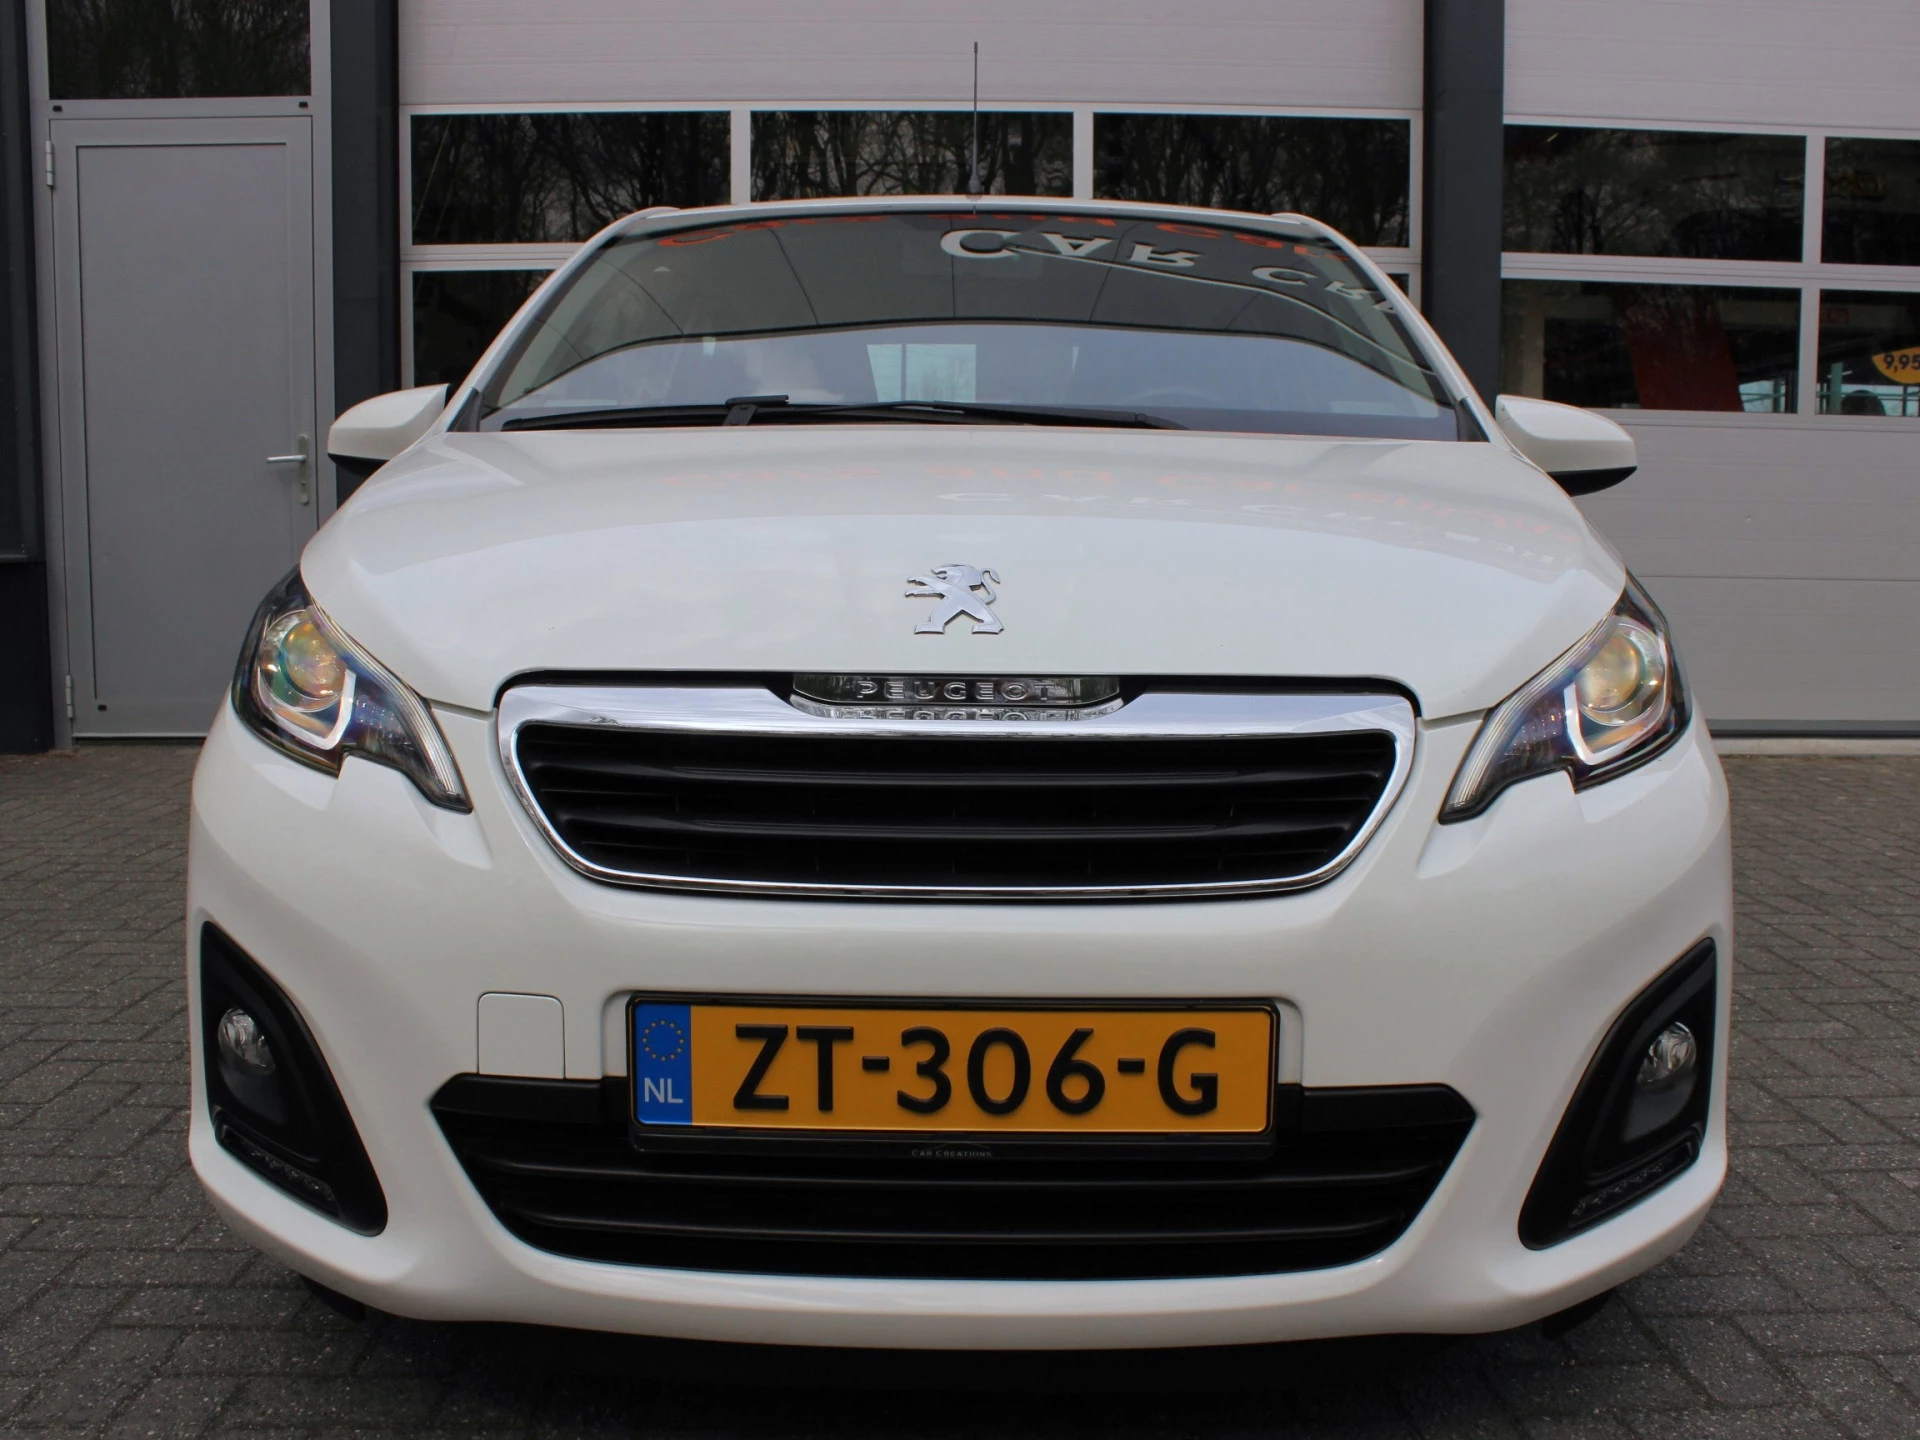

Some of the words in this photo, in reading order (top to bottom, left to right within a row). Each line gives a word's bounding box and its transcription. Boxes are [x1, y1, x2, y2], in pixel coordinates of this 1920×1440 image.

[856, 680, 1057, 701] PEUGEOT
[733, 1023, 1219, 1116] ZT-306-G
[644, 1077, 683, 1105] NL
